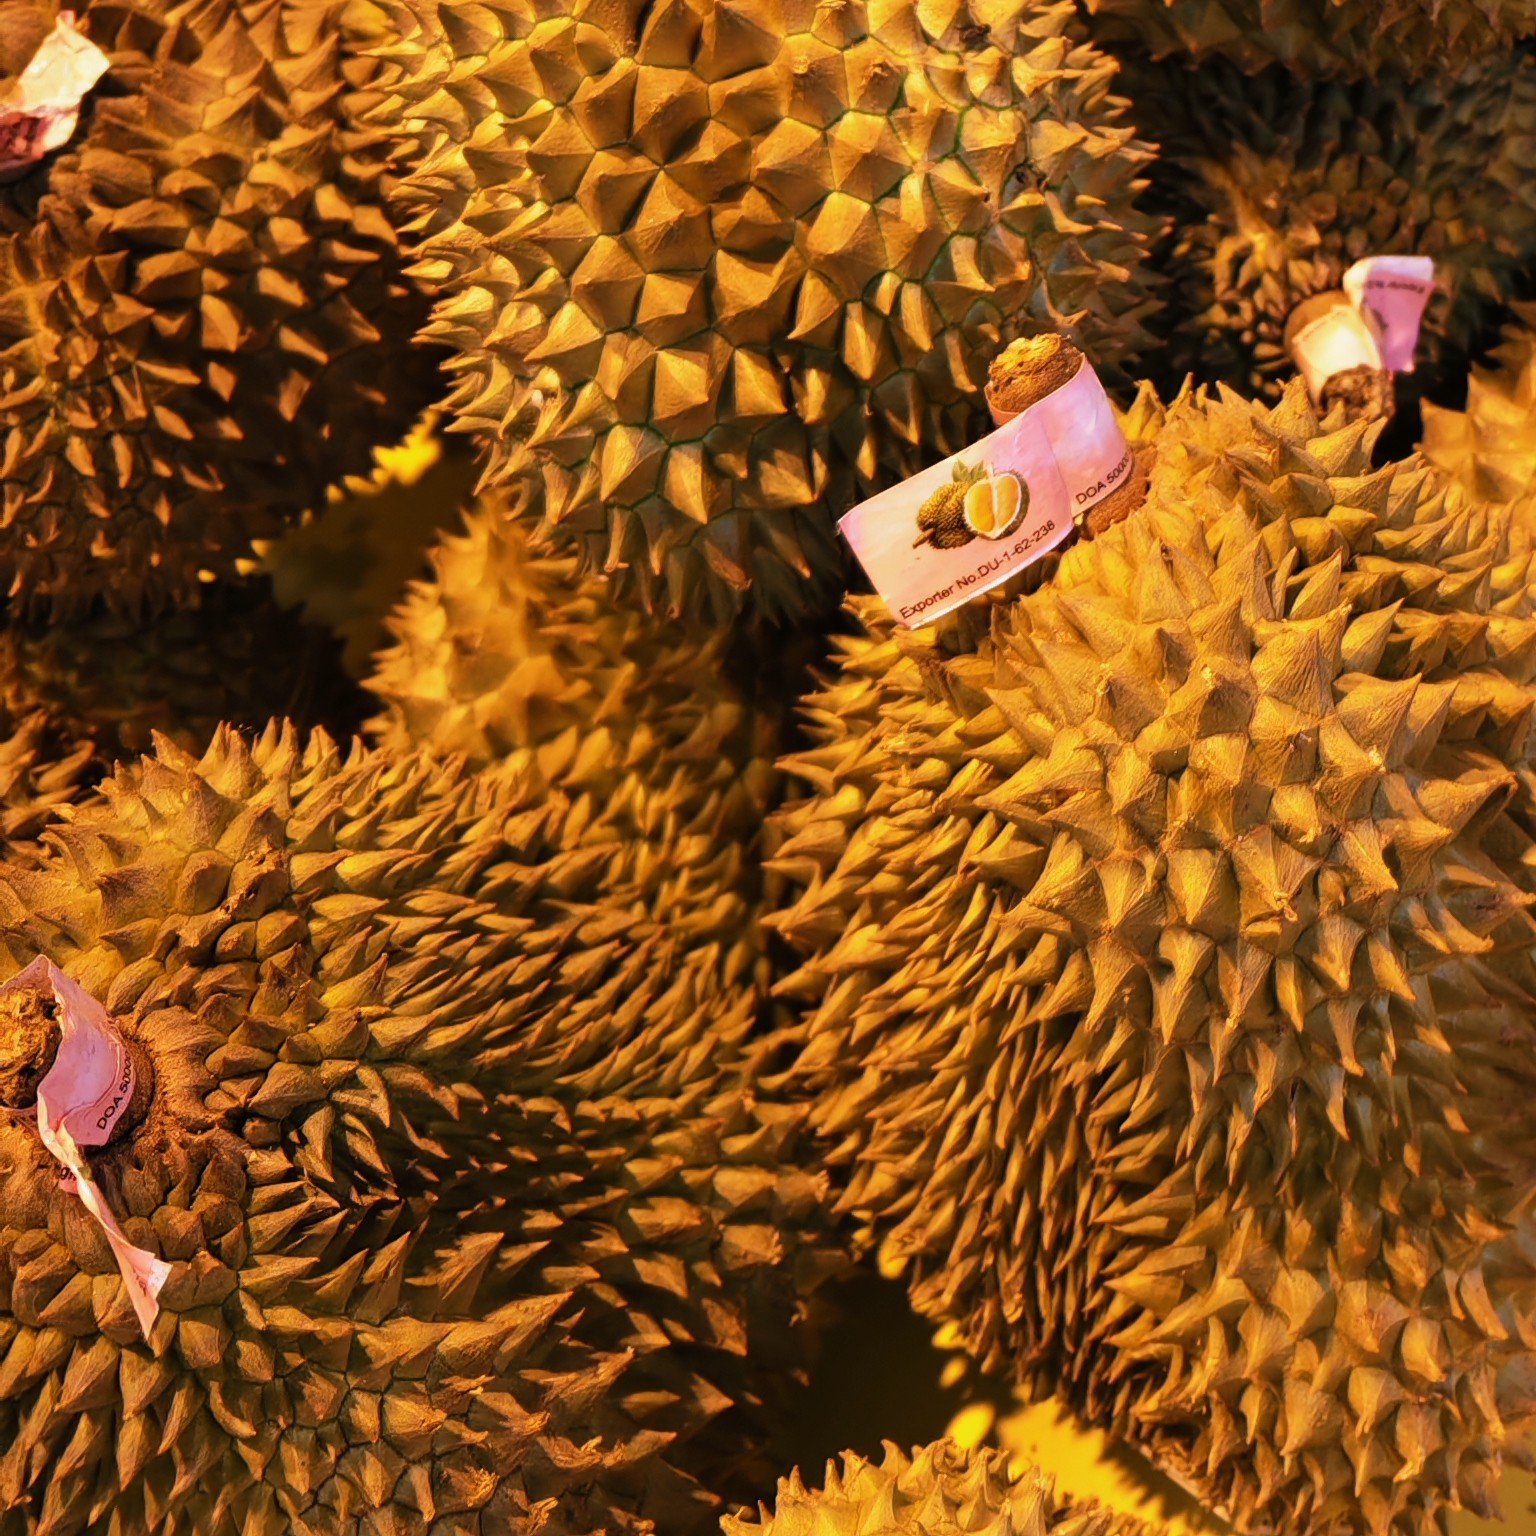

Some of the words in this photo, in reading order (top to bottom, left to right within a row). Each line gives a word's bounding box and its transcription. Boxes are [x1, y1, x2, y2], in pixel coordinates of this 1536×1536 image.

[1076, 481, 1107, 505] DOA
[899, 586, 954, 620] Exporter
[96, 1096, 123, 1130] DOA
